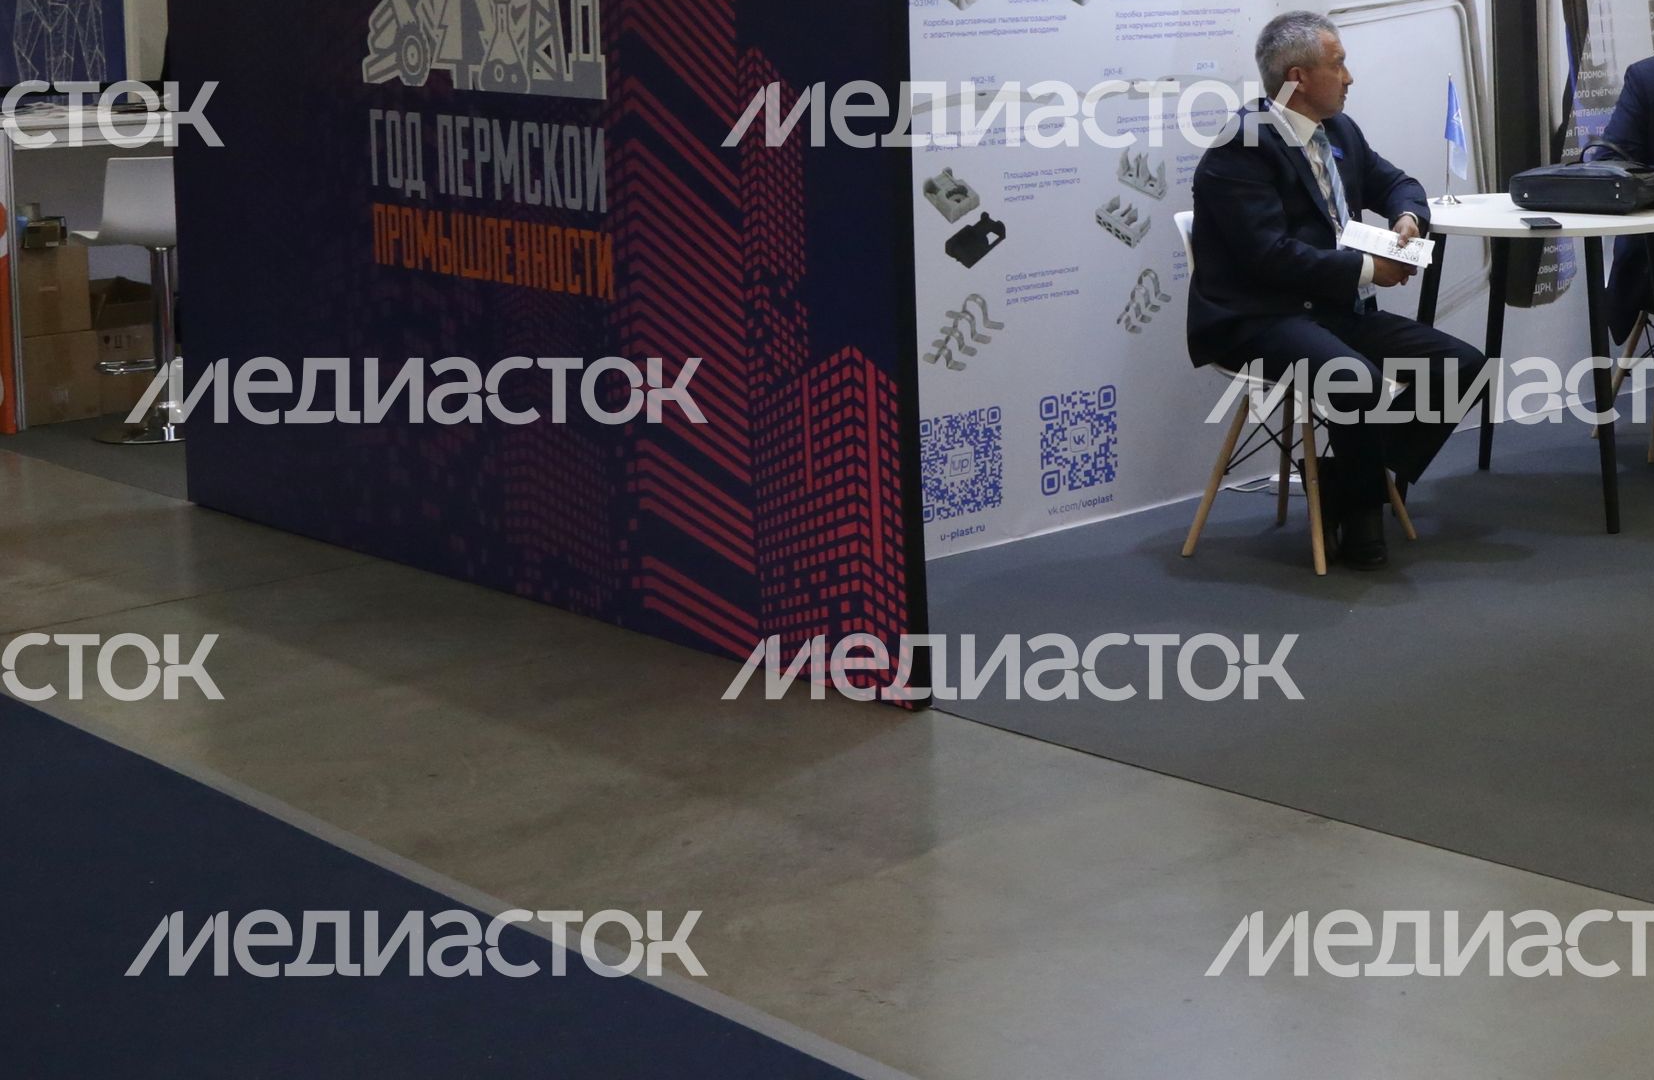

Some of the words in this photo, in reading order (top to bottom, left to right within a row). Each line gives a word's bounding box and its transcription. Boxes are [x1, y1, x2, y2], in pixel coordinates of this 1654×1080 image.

[369, 108, 427, 200] ГОД
[373, 202, 615, 301] ПРОМЫШЛЕННОСТИ
[940, 523, 986, 542] u-plast.ru
